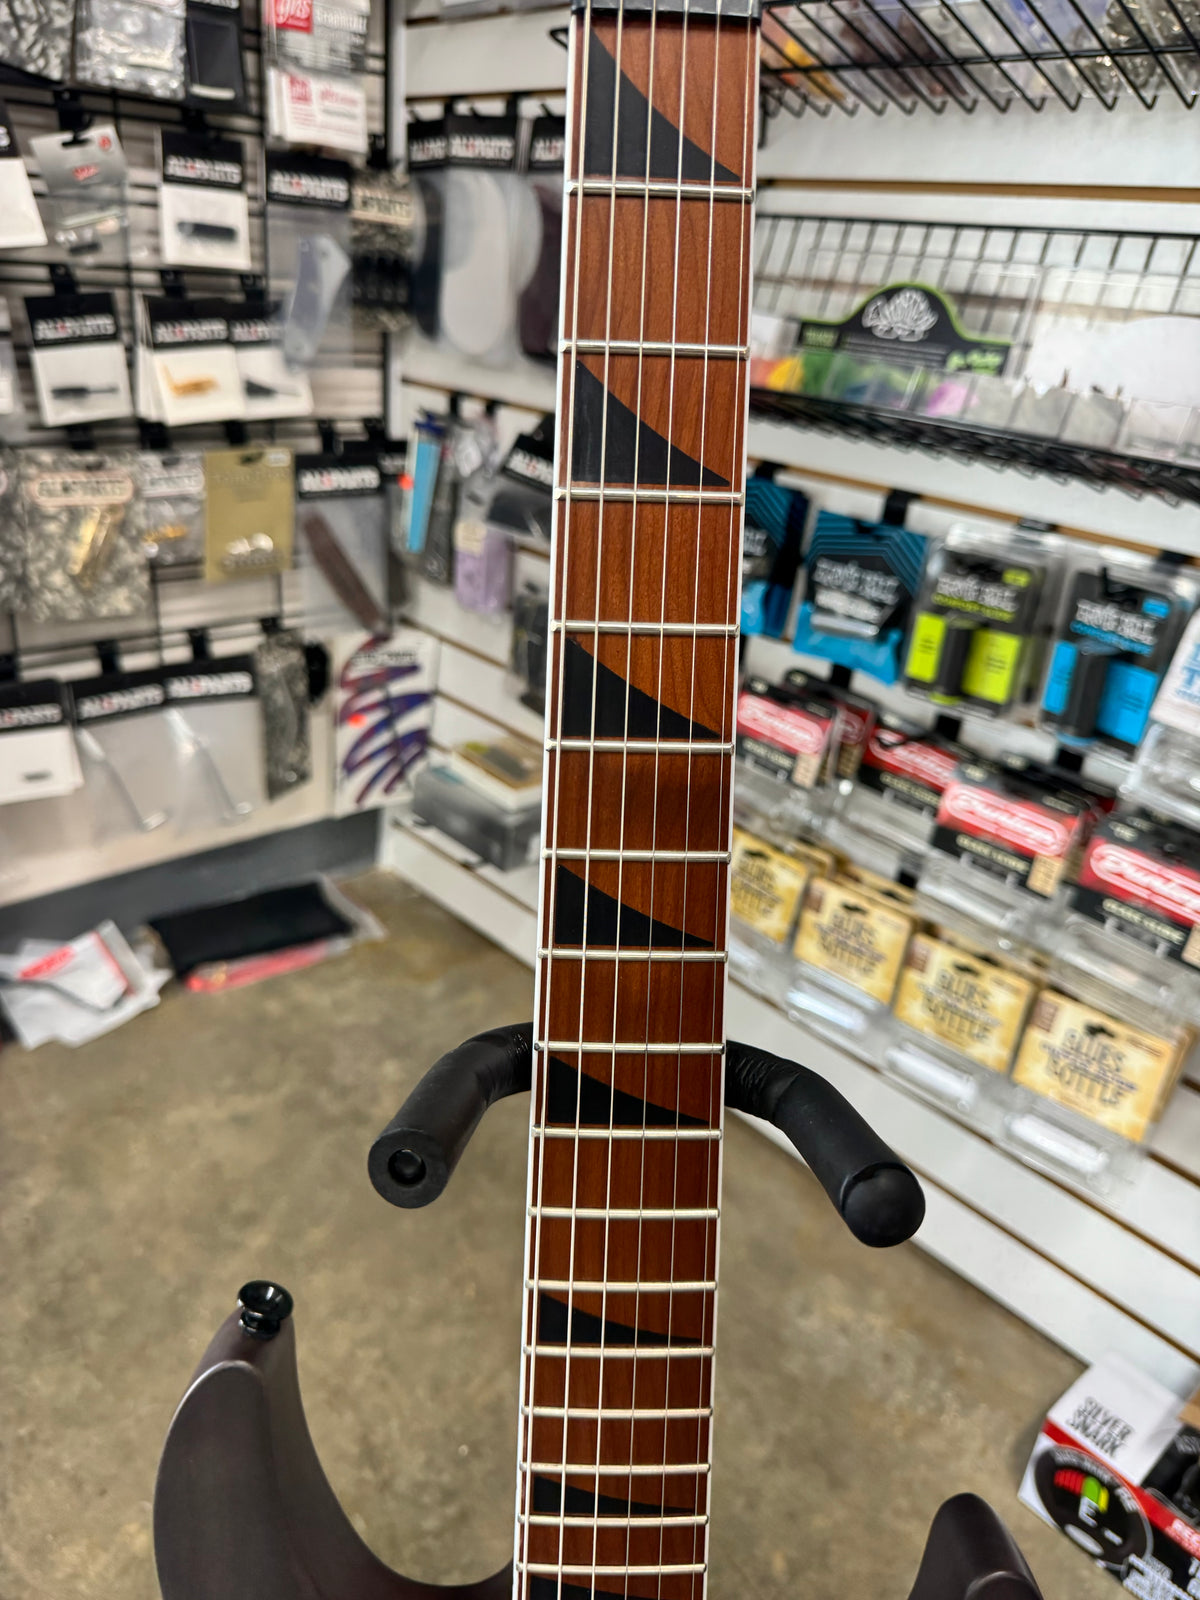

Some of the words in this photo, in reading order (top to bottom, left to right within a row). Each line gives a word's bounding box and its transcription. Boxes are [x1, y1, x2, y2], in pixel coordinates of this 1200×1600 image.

[1062, 1029, 1127, 1075] BLUES
[1067, 1414, 1124, 1459] SNARK
[1079, 1396, 1135, 1440] SILVER
